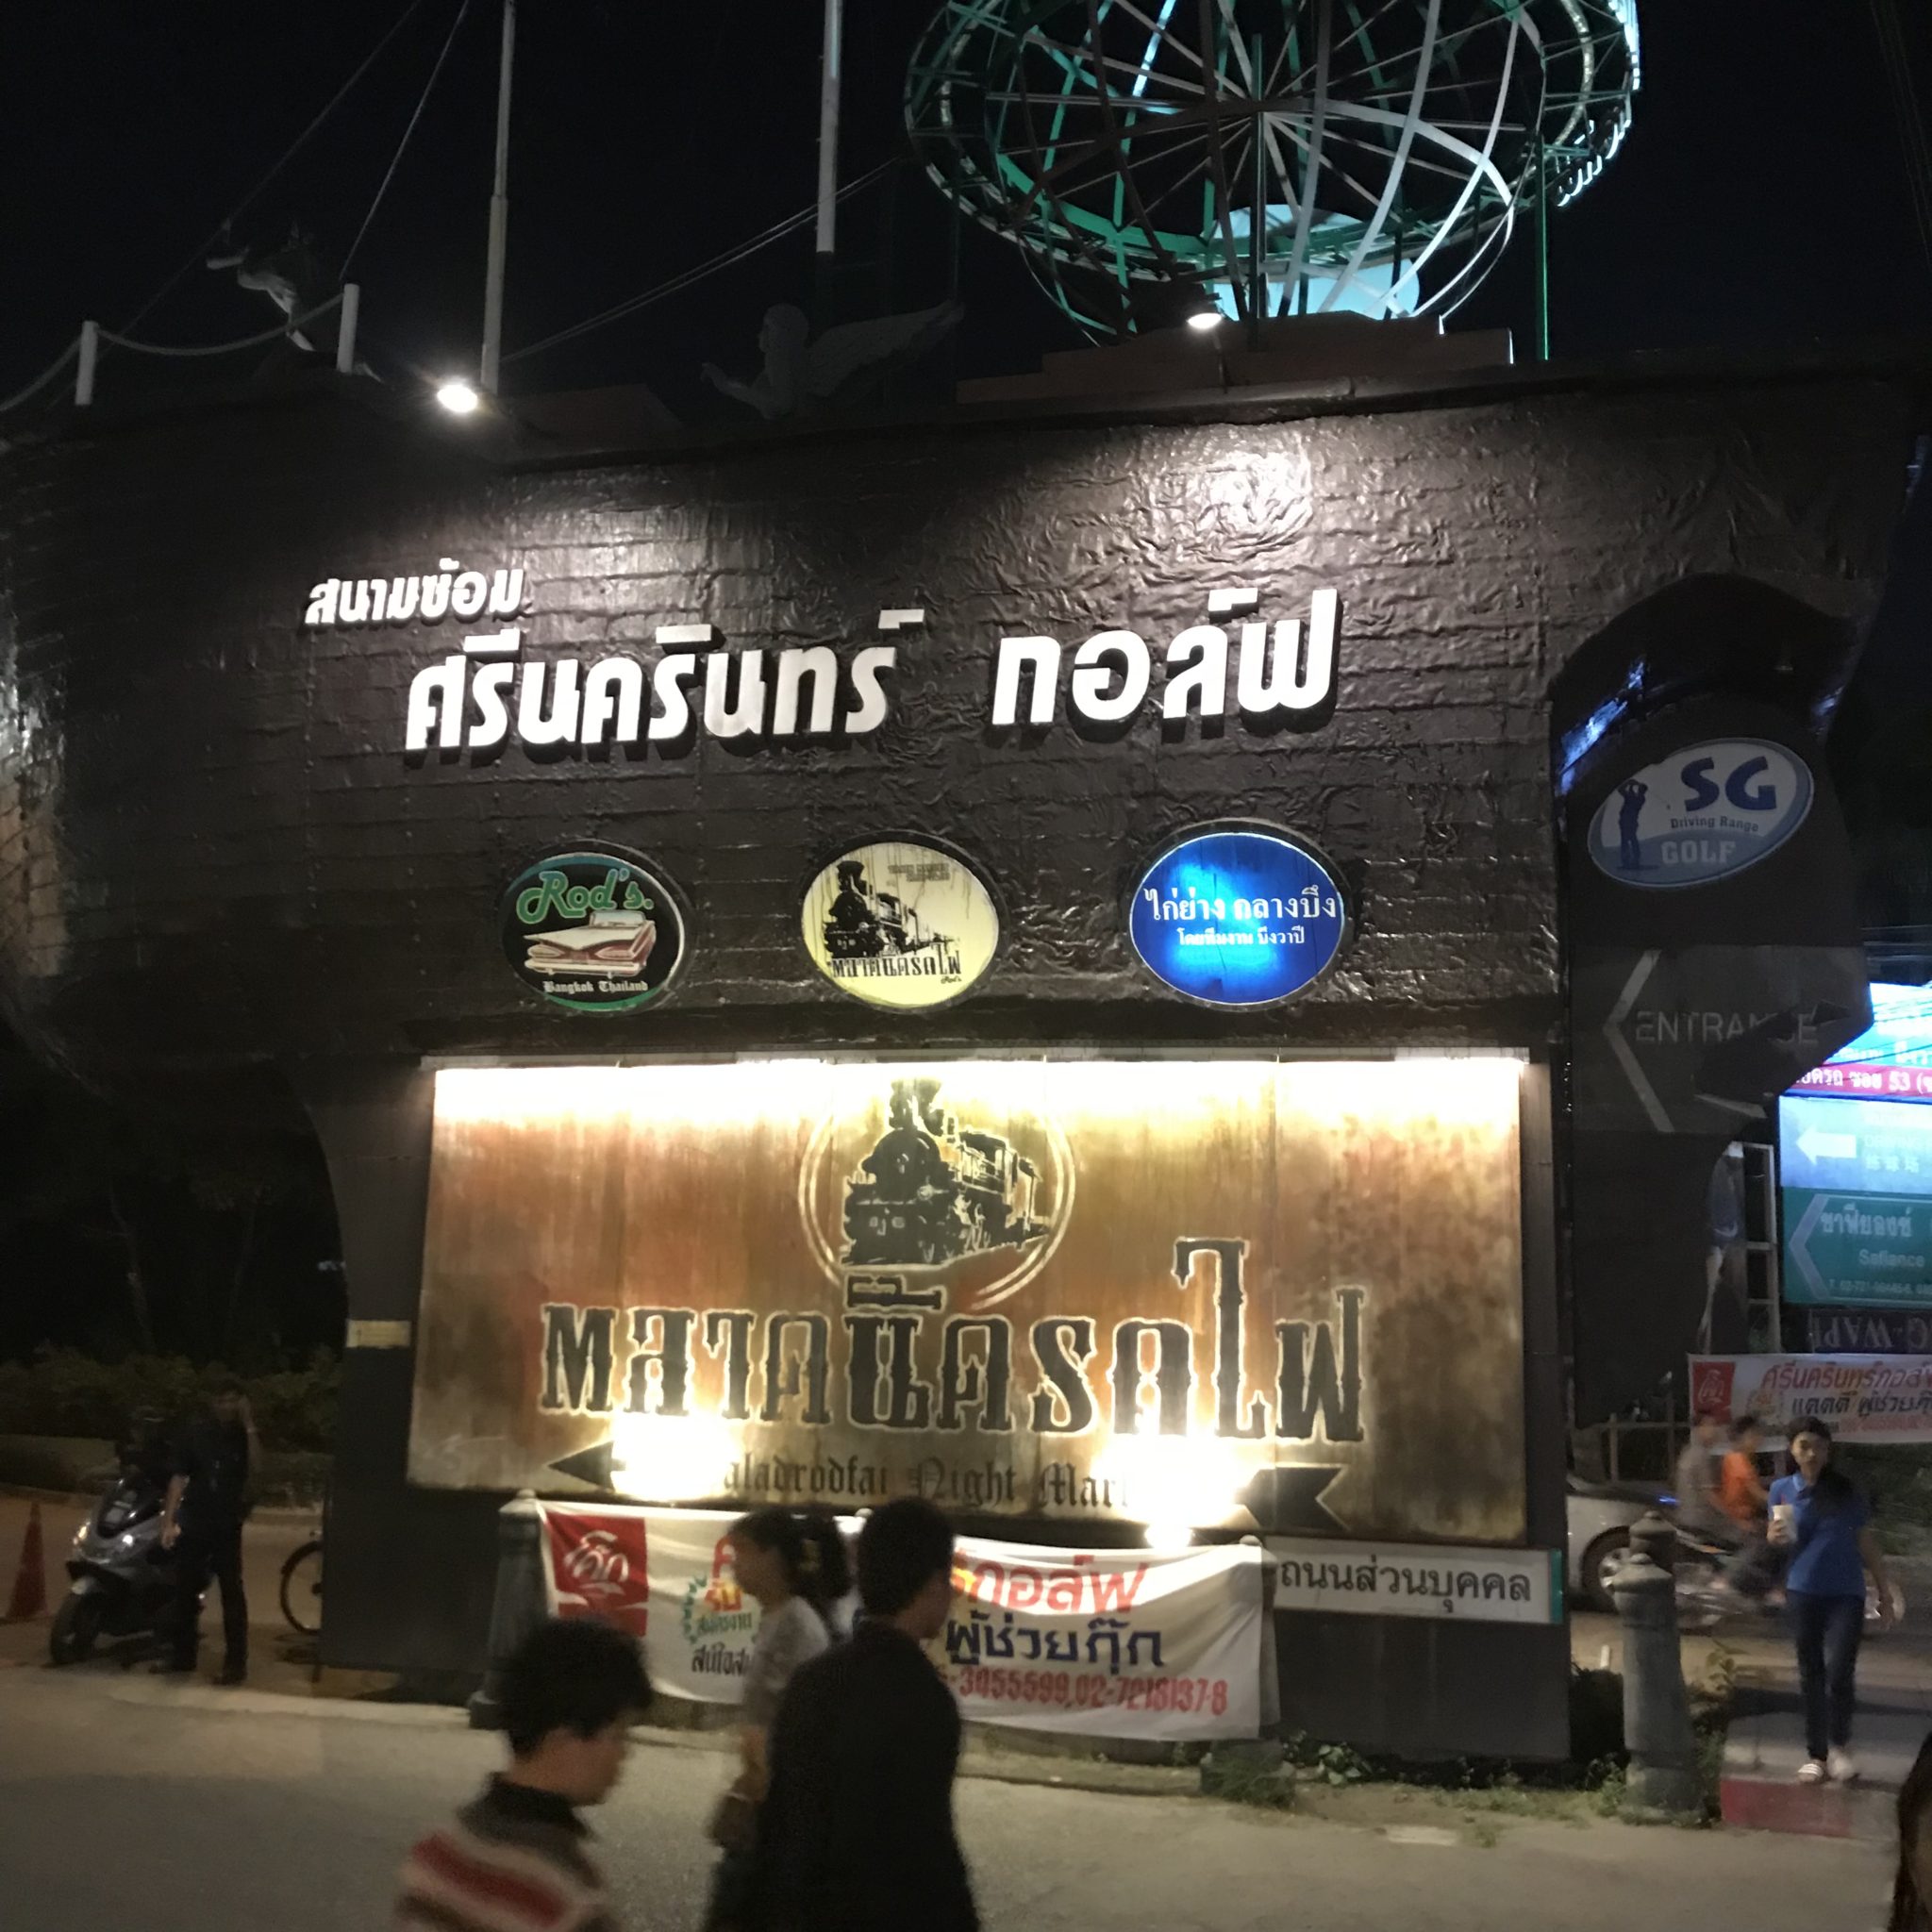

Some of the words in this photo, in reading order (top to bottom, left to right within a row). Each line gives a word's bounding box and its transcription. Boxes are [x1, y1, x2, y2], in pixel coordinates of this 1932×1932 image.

[305, 558, 524, 625] สนามซ้อม
[406, 609, 924, 750] ศรีนครินทร์
[991, 588, 1338, 726] กอล์ฟ
[1681, 756, 1777, 812] SG
[1671, 817, 1715, 829] Driving
[1721, 815, 1759, 832] Range
[1661, 840, 1736, 865] GOLF
[1143, 887, 1224, 922] ไก่ย่าง
[542, 980, 594, 994] Bangkok
[598, 979, 648, 993] Thailand
[1636, 1011, 1818, 1044] ENTRAE
[539, 1237, 1367, 1443] ตลาดนัดรถไฟ
[1761, 1360, 1932, 1390] ศรีนครินทร์กอล์
[724, 1448, 889, 1496] aladrodfai
[911, 1457, 1016, 1507] Night
[1281, 1555, 1530, 1612] ถนนส่วนบุคคล
[946, 1609, 1165, 1675] ผู้ช่วยกุ๊ก
